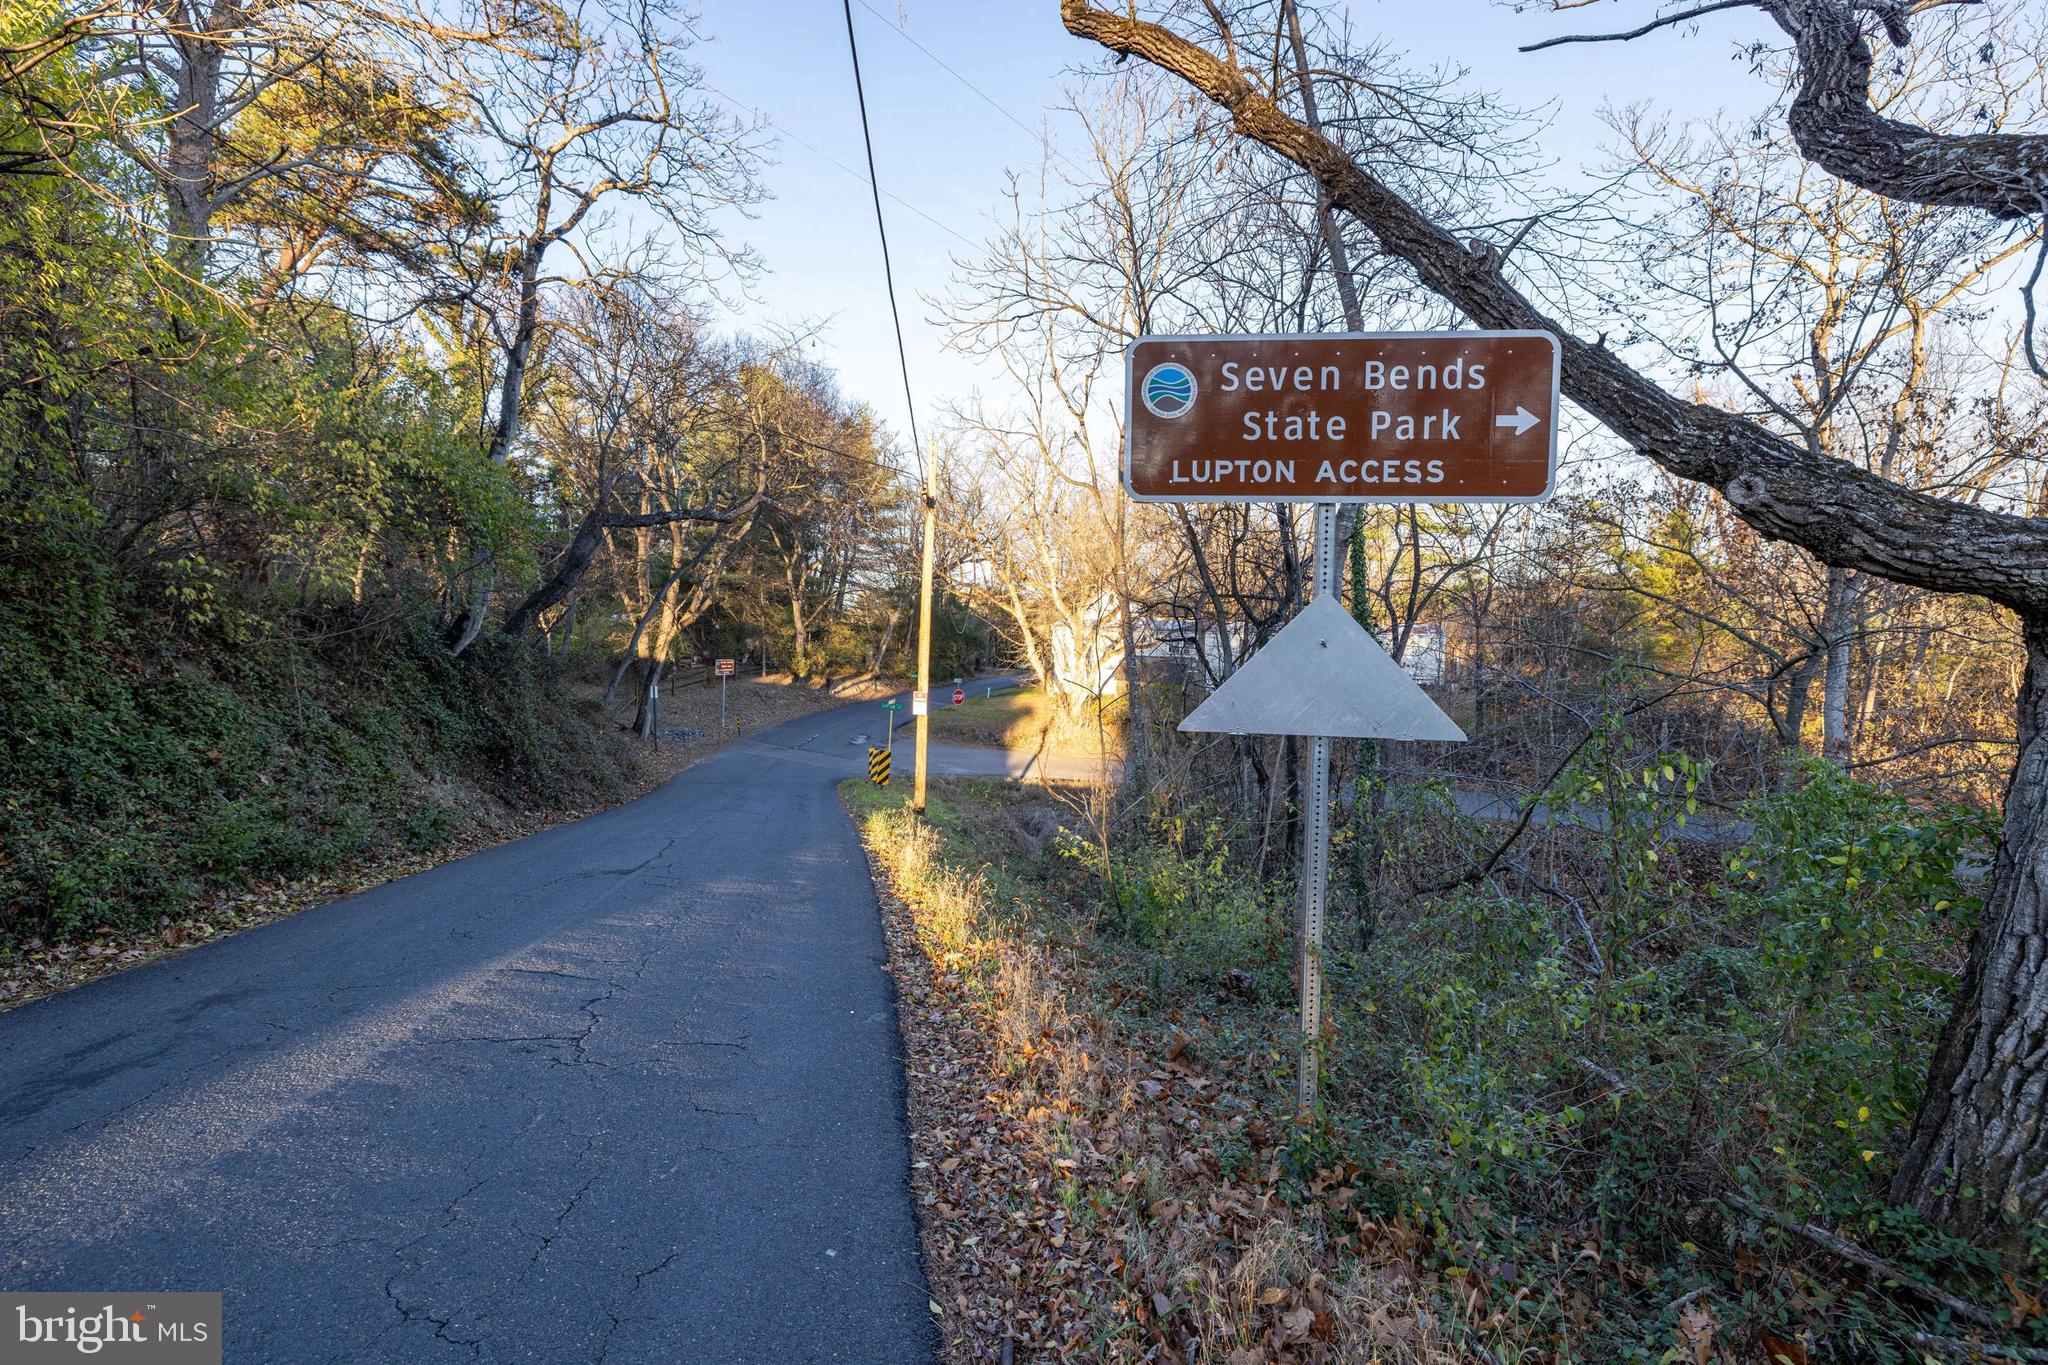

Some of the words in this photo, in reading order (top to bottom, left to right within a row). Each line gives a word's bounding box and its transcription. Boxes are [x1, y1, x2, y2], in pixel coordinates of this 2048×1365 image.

[1220, 363, 1340, 391] Seven
[1366, 358, 1487, 390] Bends
[1242, 411, 1347, 441] State
[1371, 409, 1461, 440] Park
[1172, 460, 1296, 484] LUPTON
[1315, 460, 1446, 483] ACCESS
